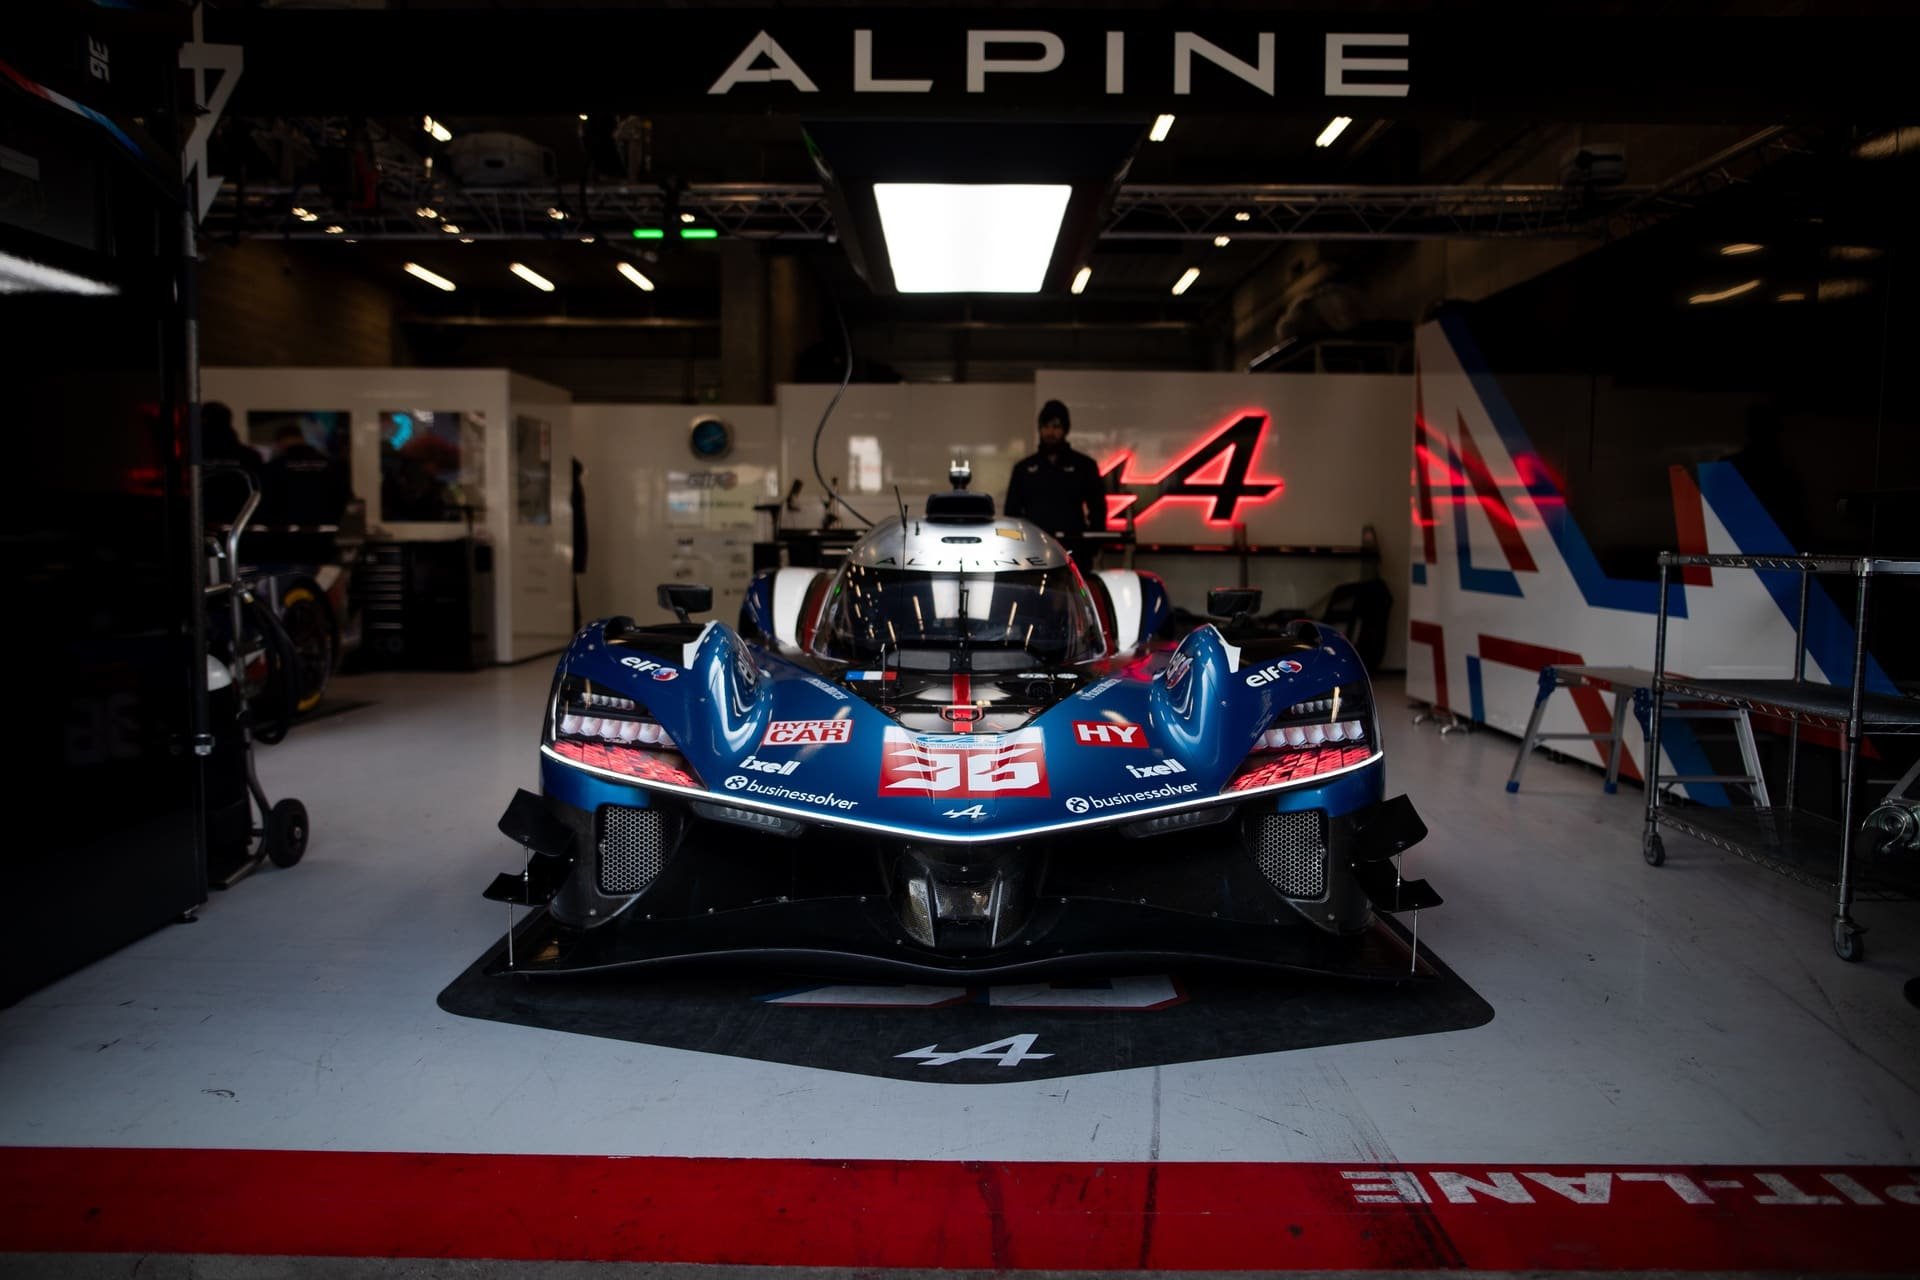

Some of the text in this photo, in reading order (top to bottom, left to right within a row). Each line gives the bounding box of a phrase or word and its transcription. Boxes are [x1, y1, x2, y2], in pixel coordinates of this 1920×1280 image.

[706, 28, 1411, 96] ALPINE
[620, 656, 662, 672] elf
[1245, 665, 1281, 688] elf
[770, 728, 843, 743] CAR
[774, 721, 846, 729] HYPER
[1076, 723, 1139, 743] HY
[739, 755, 801, 776] ixell
[884, 747, 1041, 792] 36
[1125, 758, 1187, 779] ixell
[746, 779, 858, 810] businessolver
[1089, 782, 1199, 809] businessolver
